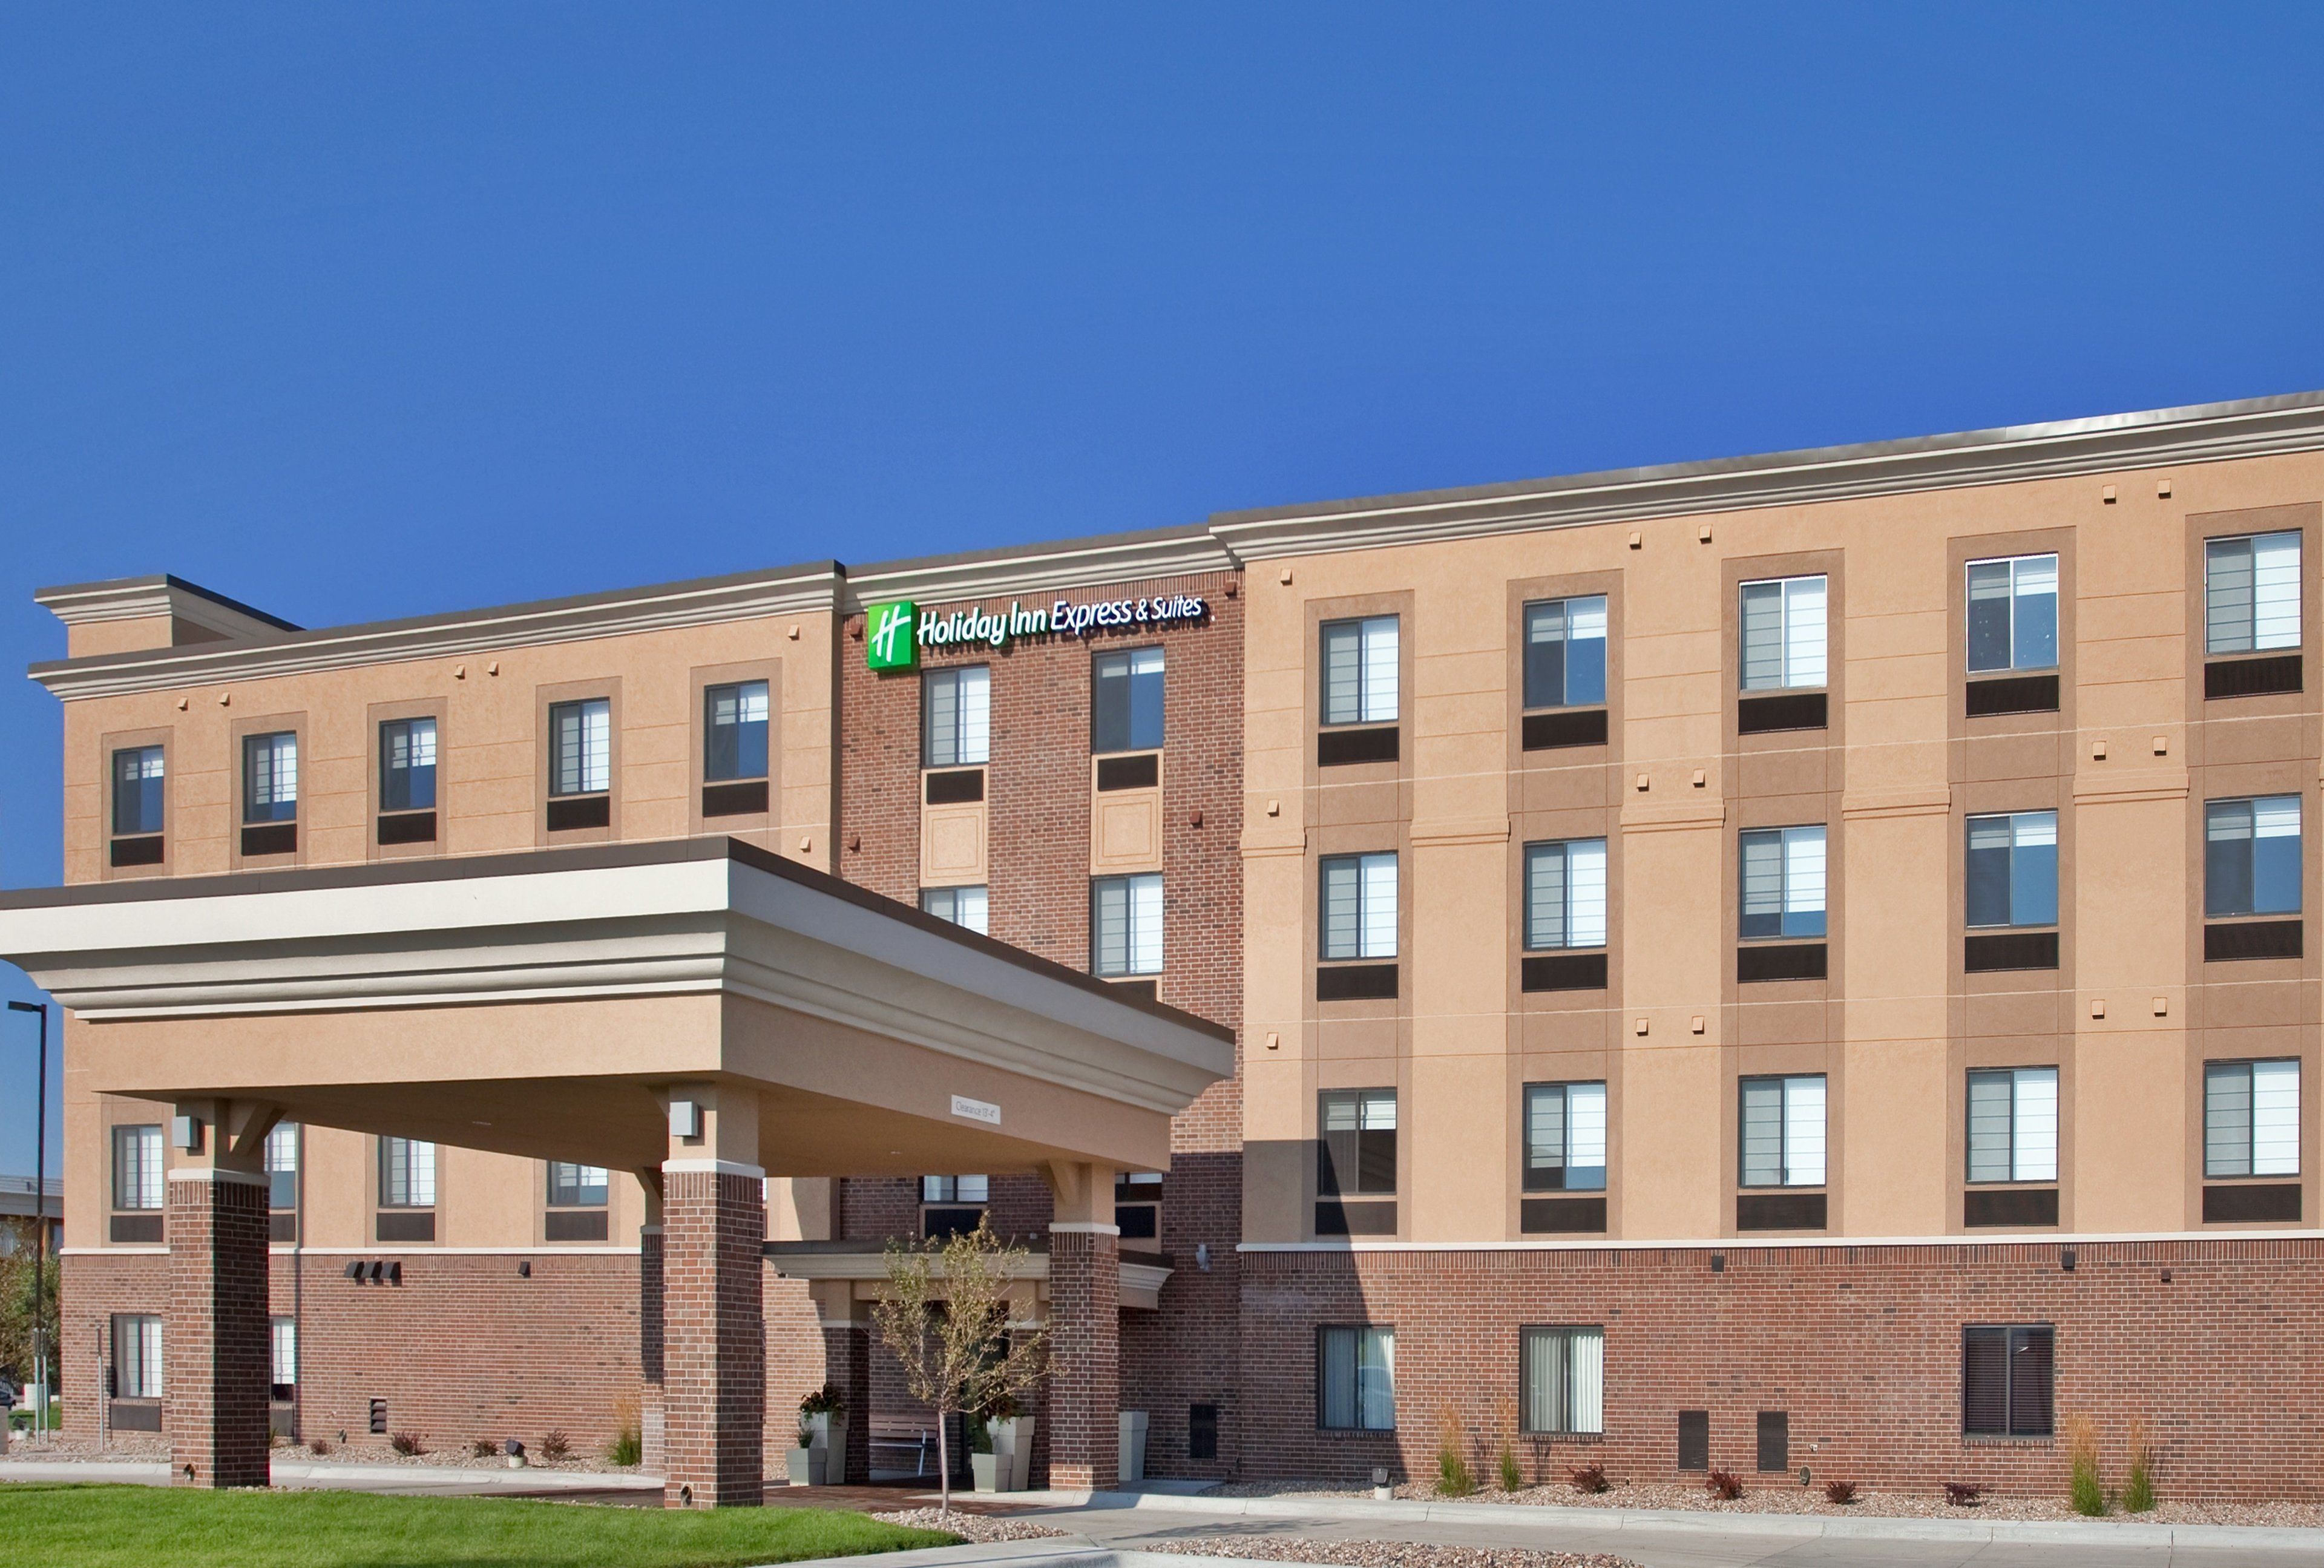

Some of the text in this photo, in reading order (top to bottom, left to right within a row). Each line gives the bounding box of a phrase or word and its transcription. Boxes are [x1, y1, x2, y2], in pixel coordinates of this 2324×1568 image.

[916, 594, 1203, 646] Holiday Inn Express & Suites
